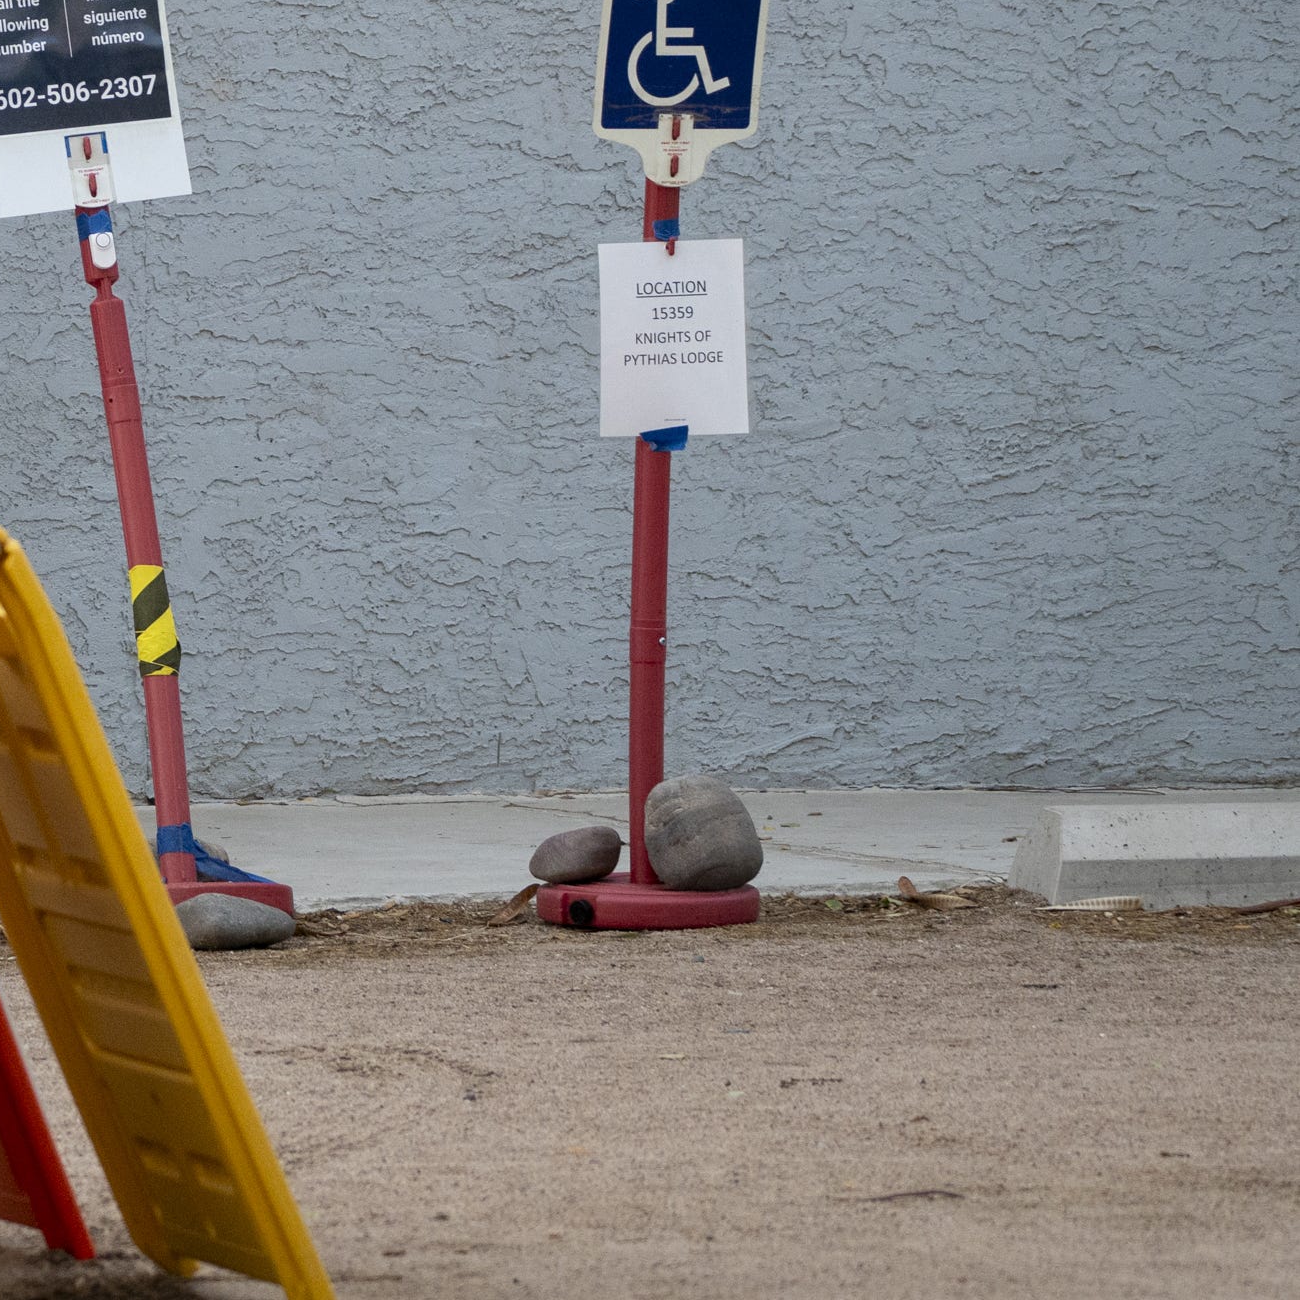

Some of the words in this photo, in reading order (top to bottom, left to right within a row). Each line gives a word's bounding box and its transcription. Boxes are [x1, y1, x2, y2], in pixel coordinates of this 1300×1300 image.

[83, 7, 147, 26] siguiente
[91, 29, 145, 47] número
[636, 280, 708, 297] LOCATION
[652, 306, 694, 320] 15359
[635, 331, 691, 345] KNIGHTS
[694, 330, 712, 342] OF
[624, 353, 677, 366] PYTHIAS
[681, 351, 724, 364] LODGE
